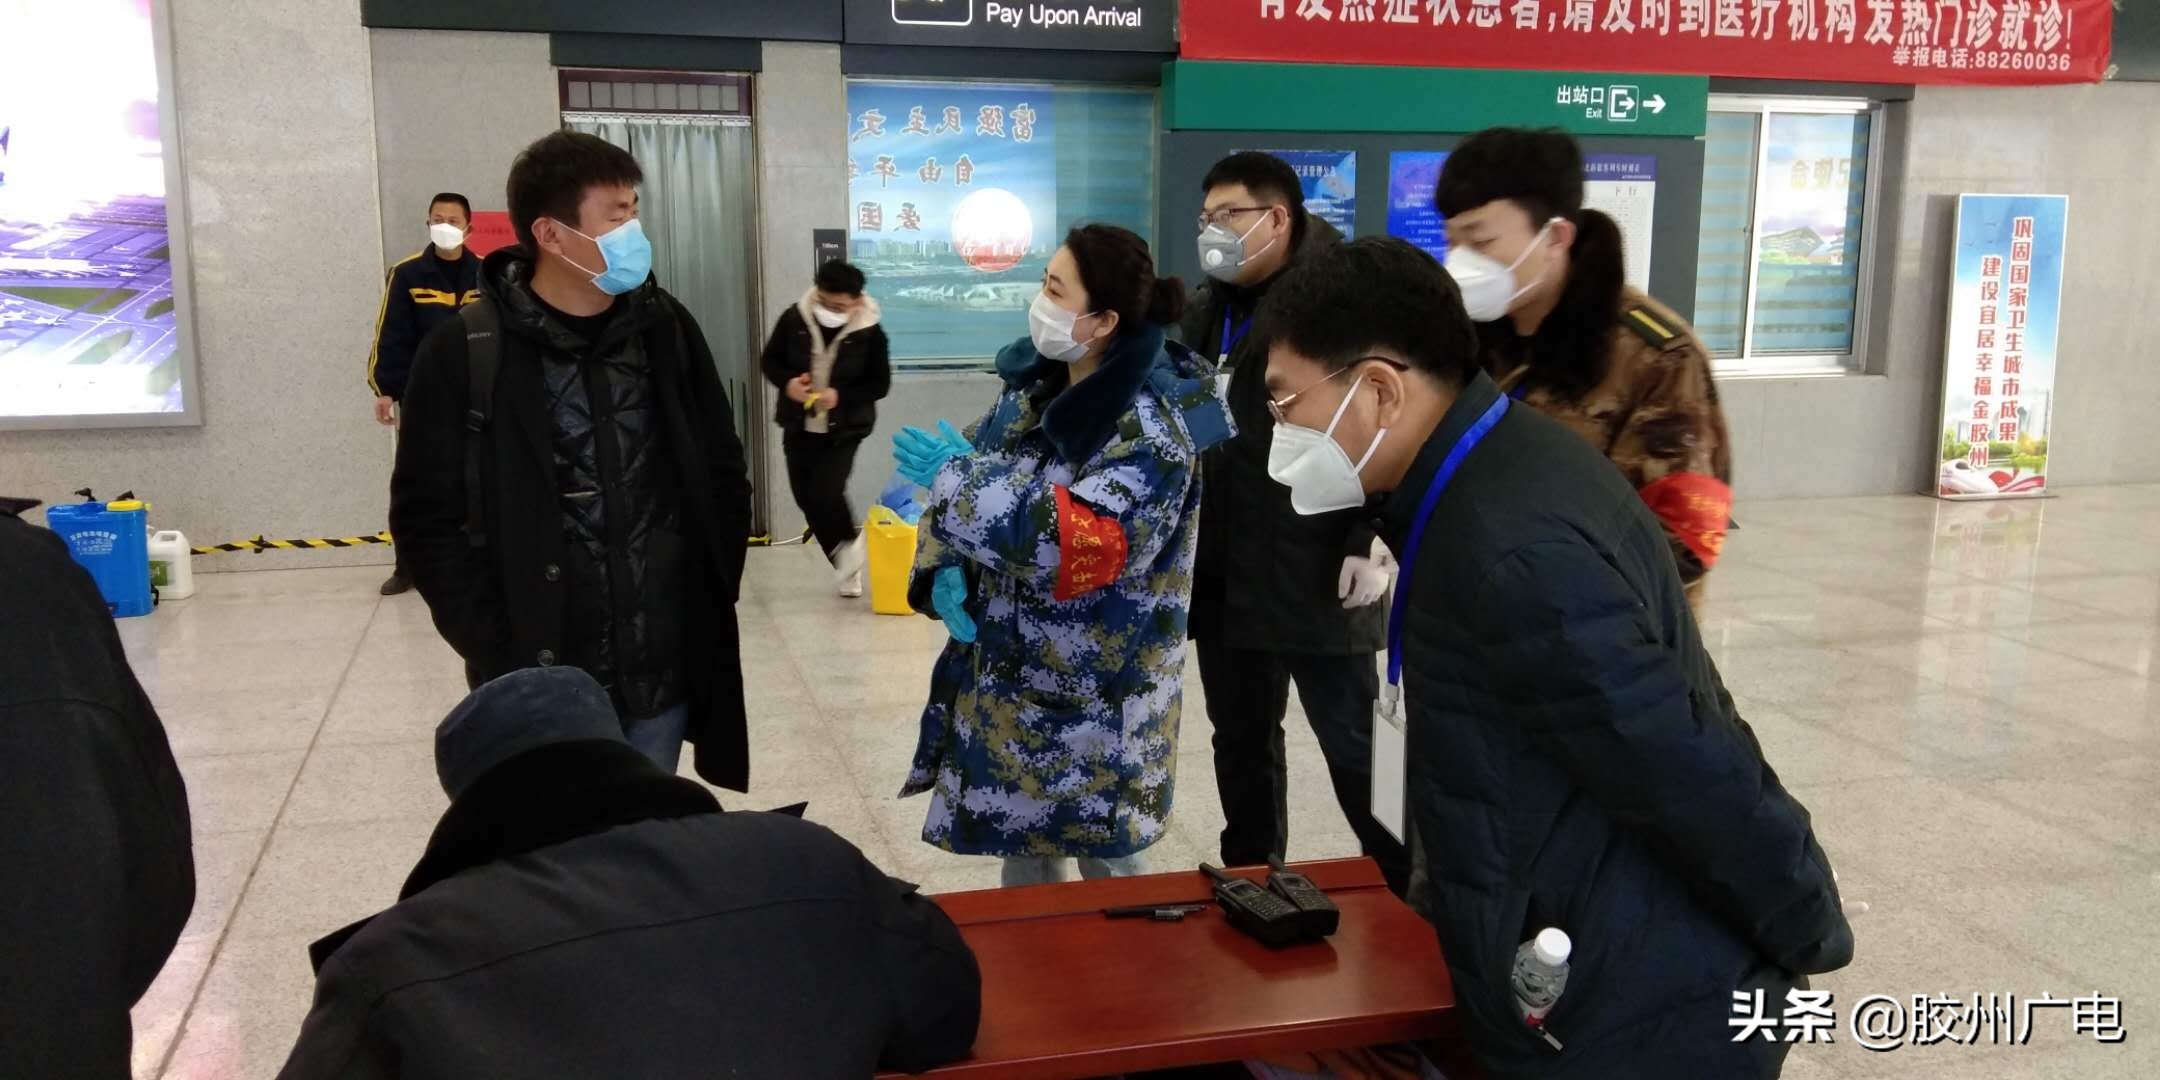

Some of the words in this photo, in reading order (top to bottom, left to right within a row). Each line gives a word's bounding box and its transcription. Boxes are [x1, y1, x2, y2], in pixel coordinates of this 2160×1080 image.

[986, 4, 1022, 27] Pay
[1029, 5, 1079, 28] Upon
[1083, 6, 1142, 27] Arrival
[1892, 46, 2071, 71] 举报电话:88260036
[1556, 85, 1605, 104] 出站口
[1585, 107, 1603, 118] Exit
[1998, 217, 2033, 441] 巩固国家卫生城市成果
[1968, 255, 2001, 468] 建设宜居幸福金胶州
